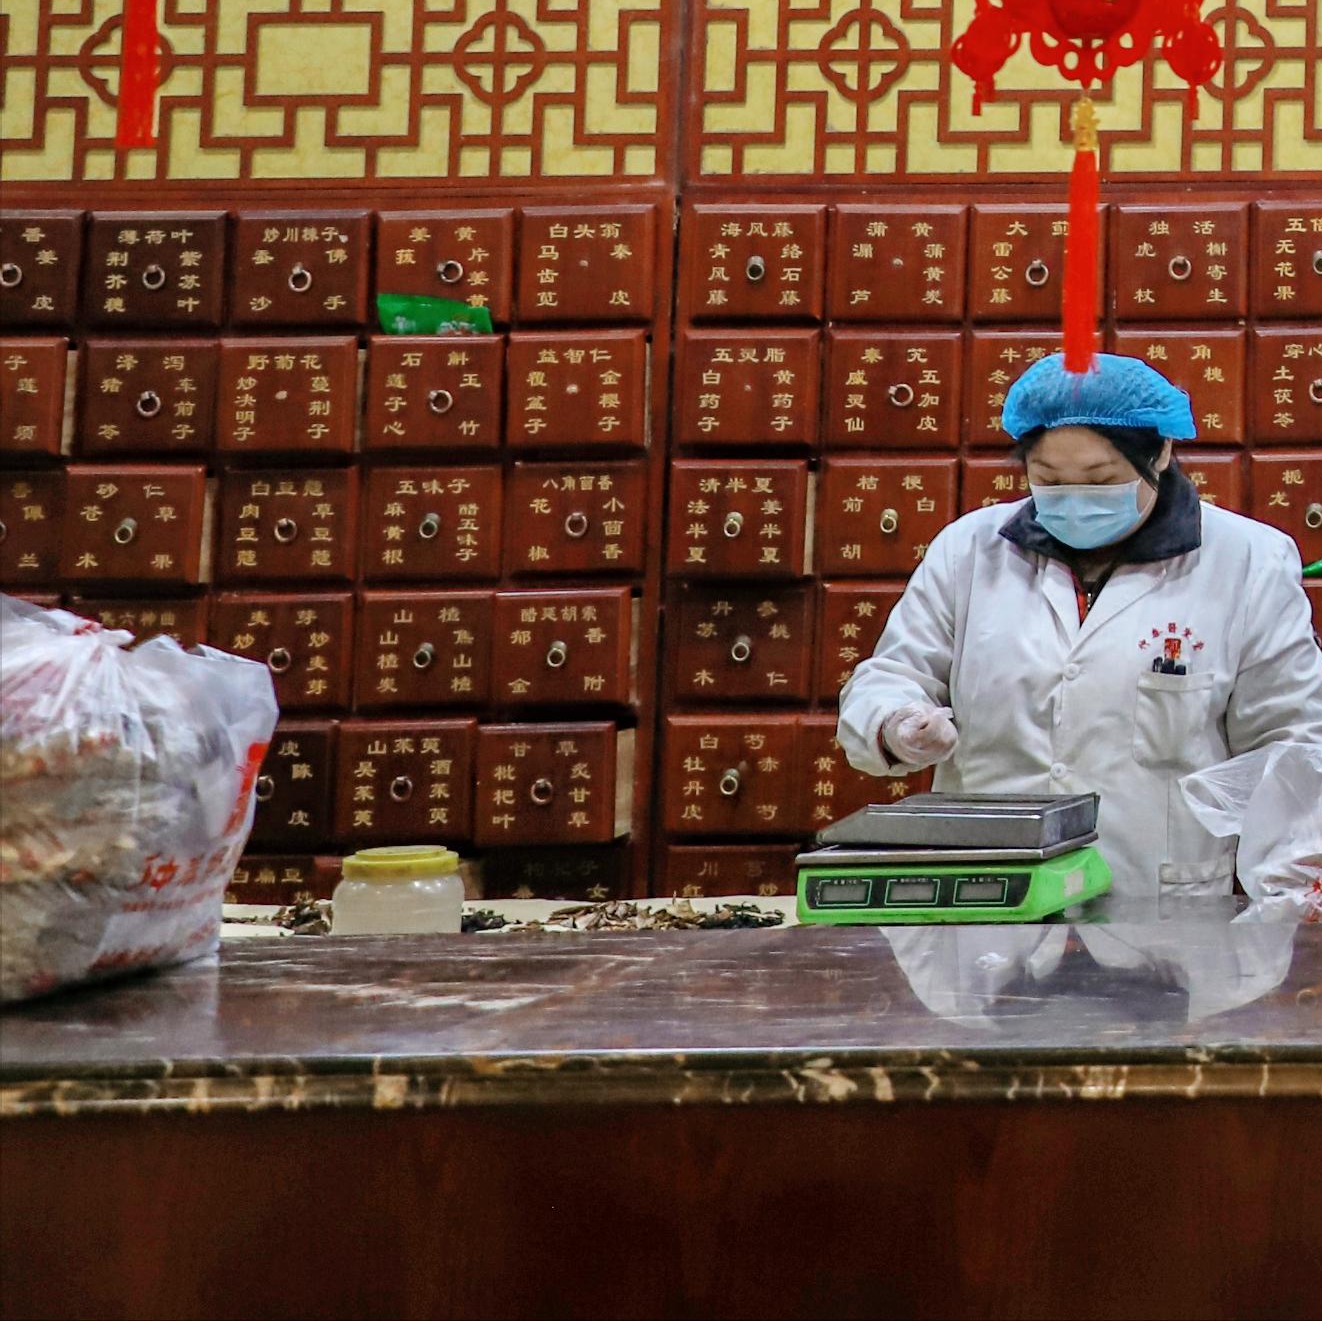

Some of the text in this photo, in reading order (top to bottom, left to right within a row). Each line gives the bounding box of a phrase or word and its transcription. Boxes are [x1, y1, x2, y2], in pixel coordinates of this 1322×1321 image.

[118, 230, 193, 244] 薄荷叶
[550, 223, 621, 238] 白头翁
[721, 222, 793, 237] 海风藤
[1149, 221, 1215, 235] 独活
[537, 246, 559, 306] 马齿苋
[990, 242, 1012, 303] 雷公藤
[1274, 240, 1296, 300] 无花果
[247, 354, 321, 370] 野菊花
[537, 349, 611, 363] 益智仁
[712, 348, 785, 362] 五灵脂
[172, 378, 196, 439] 车前子
[233, 377, 257, 441] 炒决明子
[384, 374, 407, 435] 莲子心
[598, 370, 621, 431] 金樱子
[698, 370, 720, 431] 白药子
[771, 370, 795, 431] 黄药子
[845, 370, 868, 432] 威灵仙
[917, 370, 940, 431] 五加皮
[1273, 366, 1294, 427] 土茯苓
[252, 481, 324, 496] 白豆蔻
[396, 479, 470, 494] 五味子
[543, 475, 612, 490] 八角茴香
[699, 478, 773, 493] 清半夏
[857, 475, 923, 490] 桔梗
[236, 504, 259, 566] 肉豆蔻
[383, 502, 405, 564] 麻黄根
[528, 498, 551, 561] 花椒
[603, 497, 624, 559] 小茴香
[686, 500, 709, 563] 法半夏
[759, 499, 782, 563] 姜半夏
[841, 497, 864, 559] 前胡
[521, 606, 596, 622] 醋延胡索
[509, 741, 578, 757] 甘草
[493, 765, 515, 829] 枇杷叶
[568, 763, 591, 827] 炙甘草
[682, 757, 705, 819] 牡丹皮
